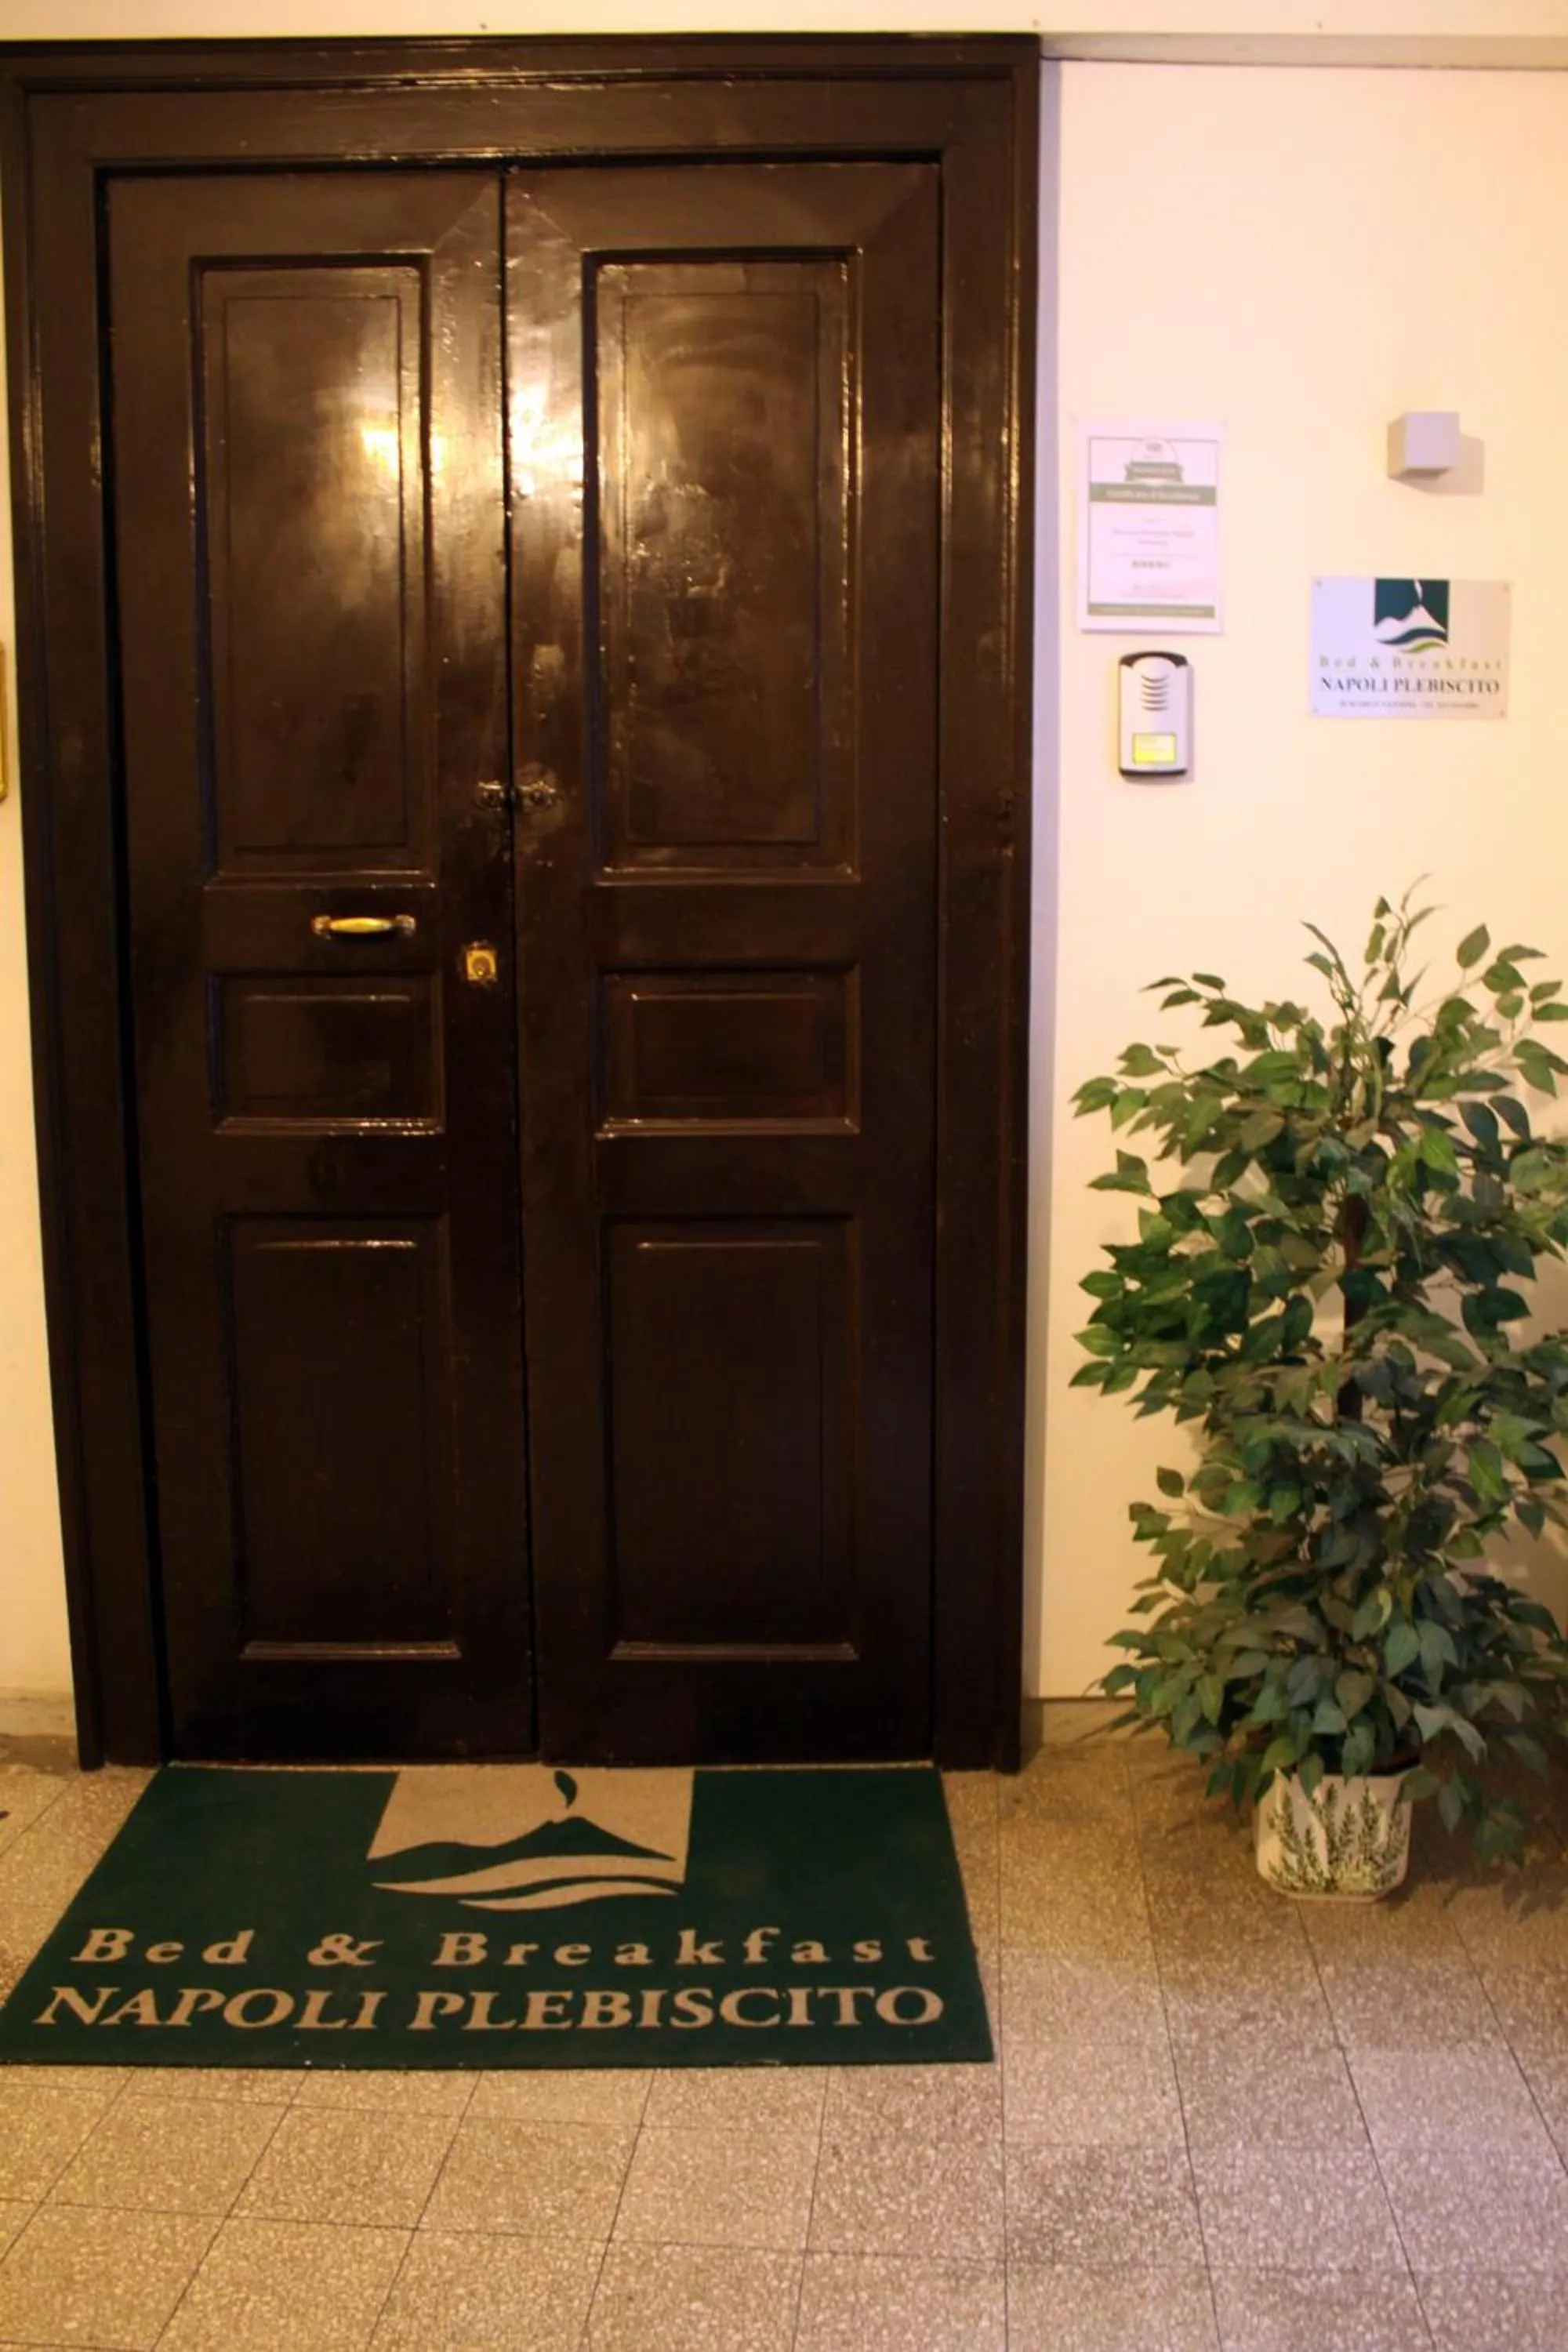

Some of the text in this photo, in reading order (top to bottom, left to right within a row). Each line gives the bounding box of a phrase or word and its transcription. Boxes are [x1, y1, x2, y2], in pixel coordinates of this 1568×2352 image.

[1320, 677, 1501, 694] NAPOLI PLEBISCITO
[71, 1927, 937, 1966] Bed & Breakfast
[32, 1986, 944, 2031] NAPOLI PLEBISCITO
